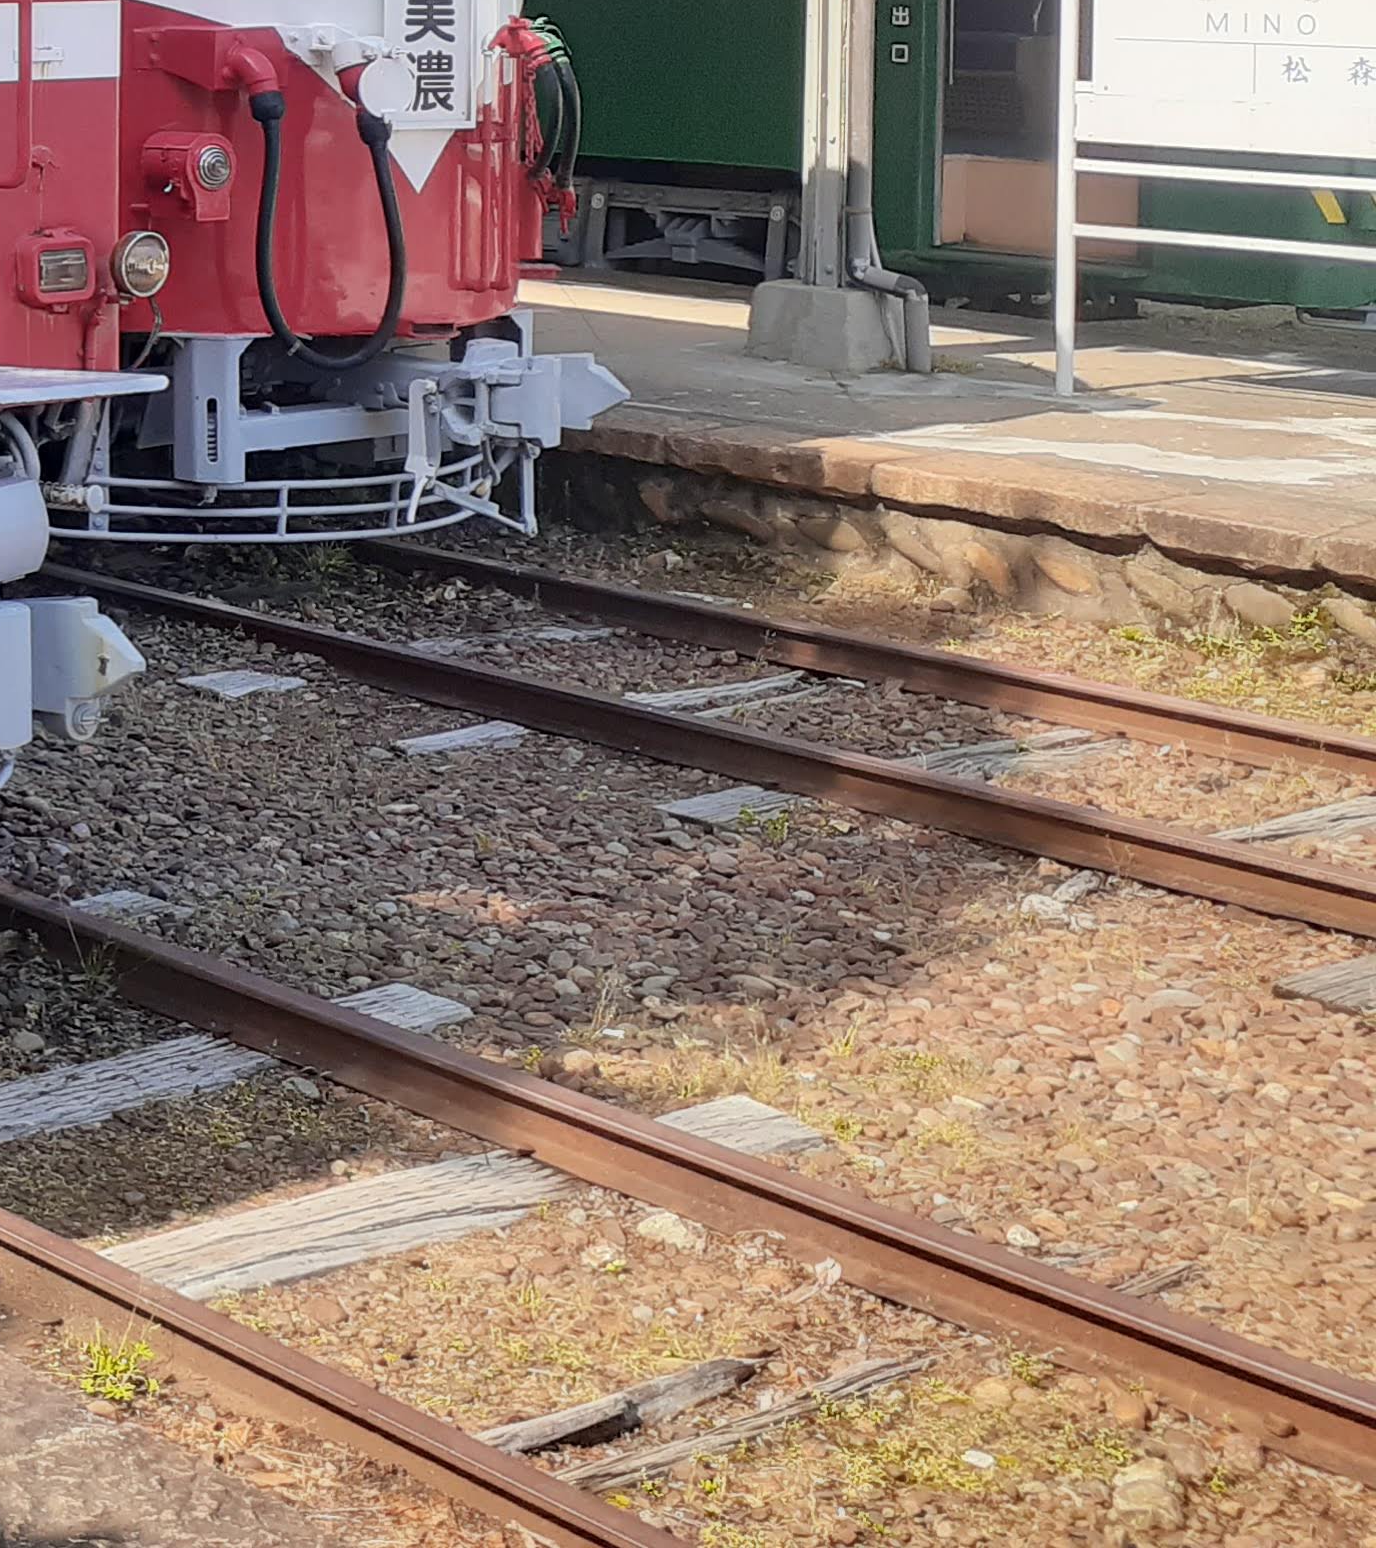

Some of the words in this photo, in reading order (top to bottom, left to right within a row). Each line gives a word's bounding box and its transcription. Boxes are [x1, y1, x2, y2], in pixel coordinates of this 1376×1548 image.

[891, 6, 910, 63] 出口
[1205, 12, 1317, 36] MINO
[1281, 55, 1376, 86] 松森
